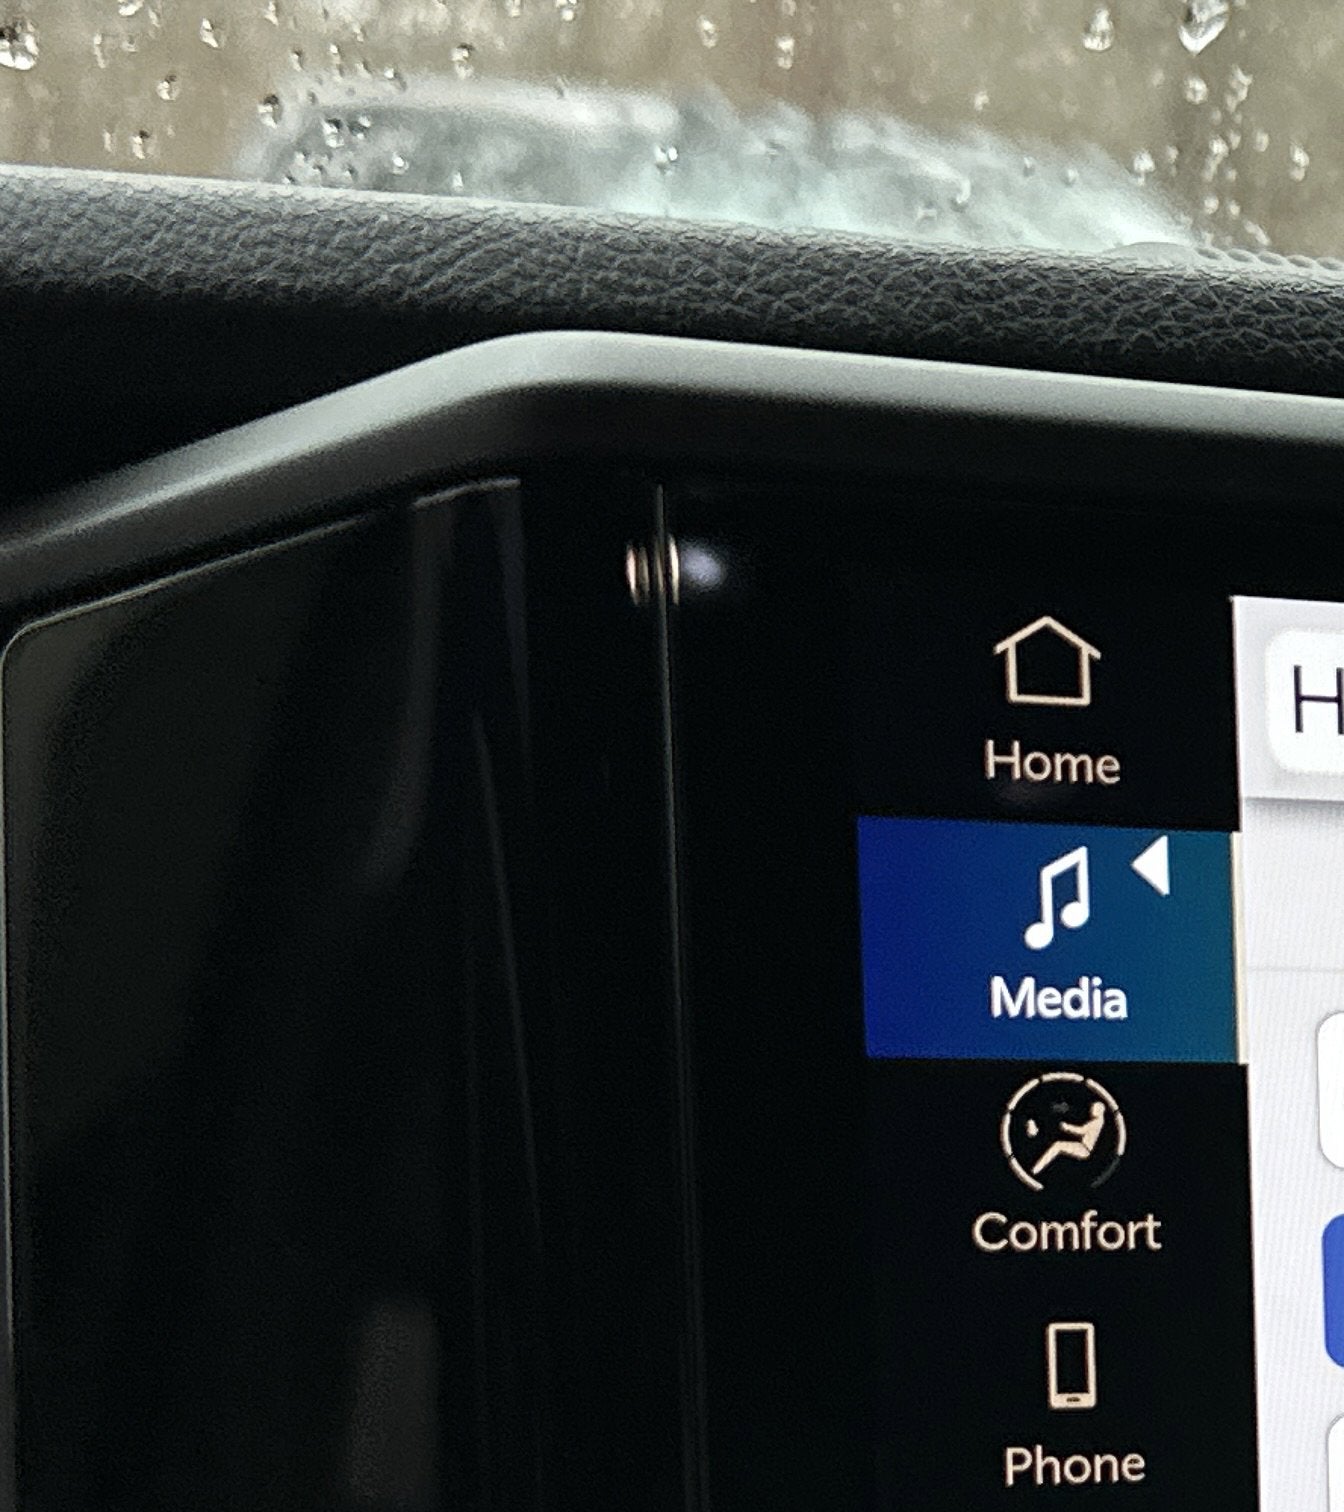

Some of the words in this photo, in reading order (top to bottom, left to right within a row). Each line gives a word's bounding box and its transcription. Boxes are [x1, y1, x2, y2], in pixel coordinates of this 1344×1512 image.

[986, 739, 1121, 784] Home
[991, 975, 1128, 1020] Media
[973, 1209, 1162, 1251] Comfort
[1005, 1444, 1146, 1486] Phone
